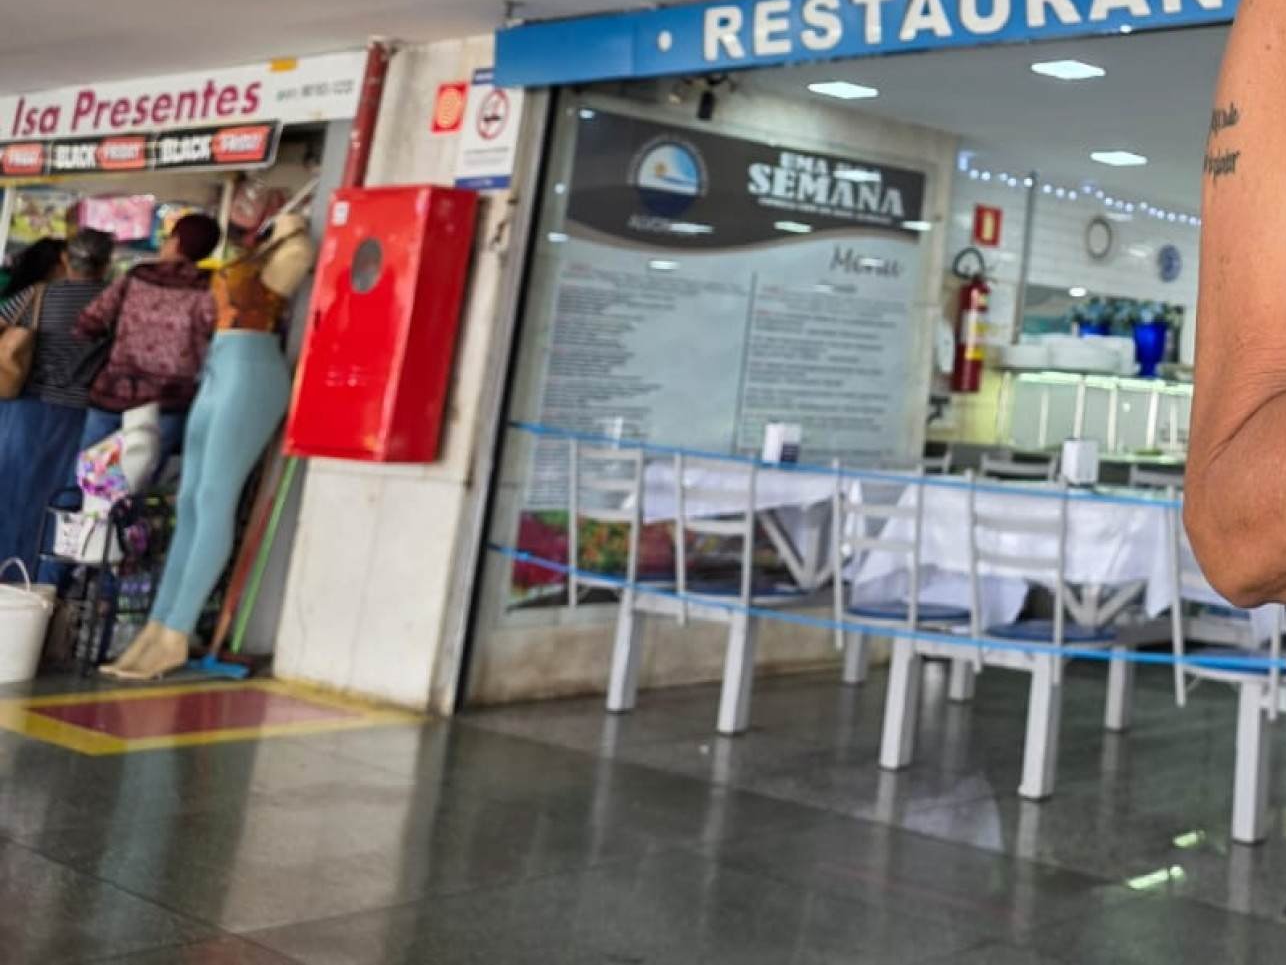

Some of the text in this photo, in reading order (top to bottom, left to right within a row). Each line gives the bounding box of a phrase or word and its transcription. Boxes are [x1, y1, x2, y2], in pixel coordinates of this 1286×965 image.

[12, 97, 60, 136] Isa
[70, 79, 263, 131] Presentes
[748, 162, 905, 217] SEMANA
